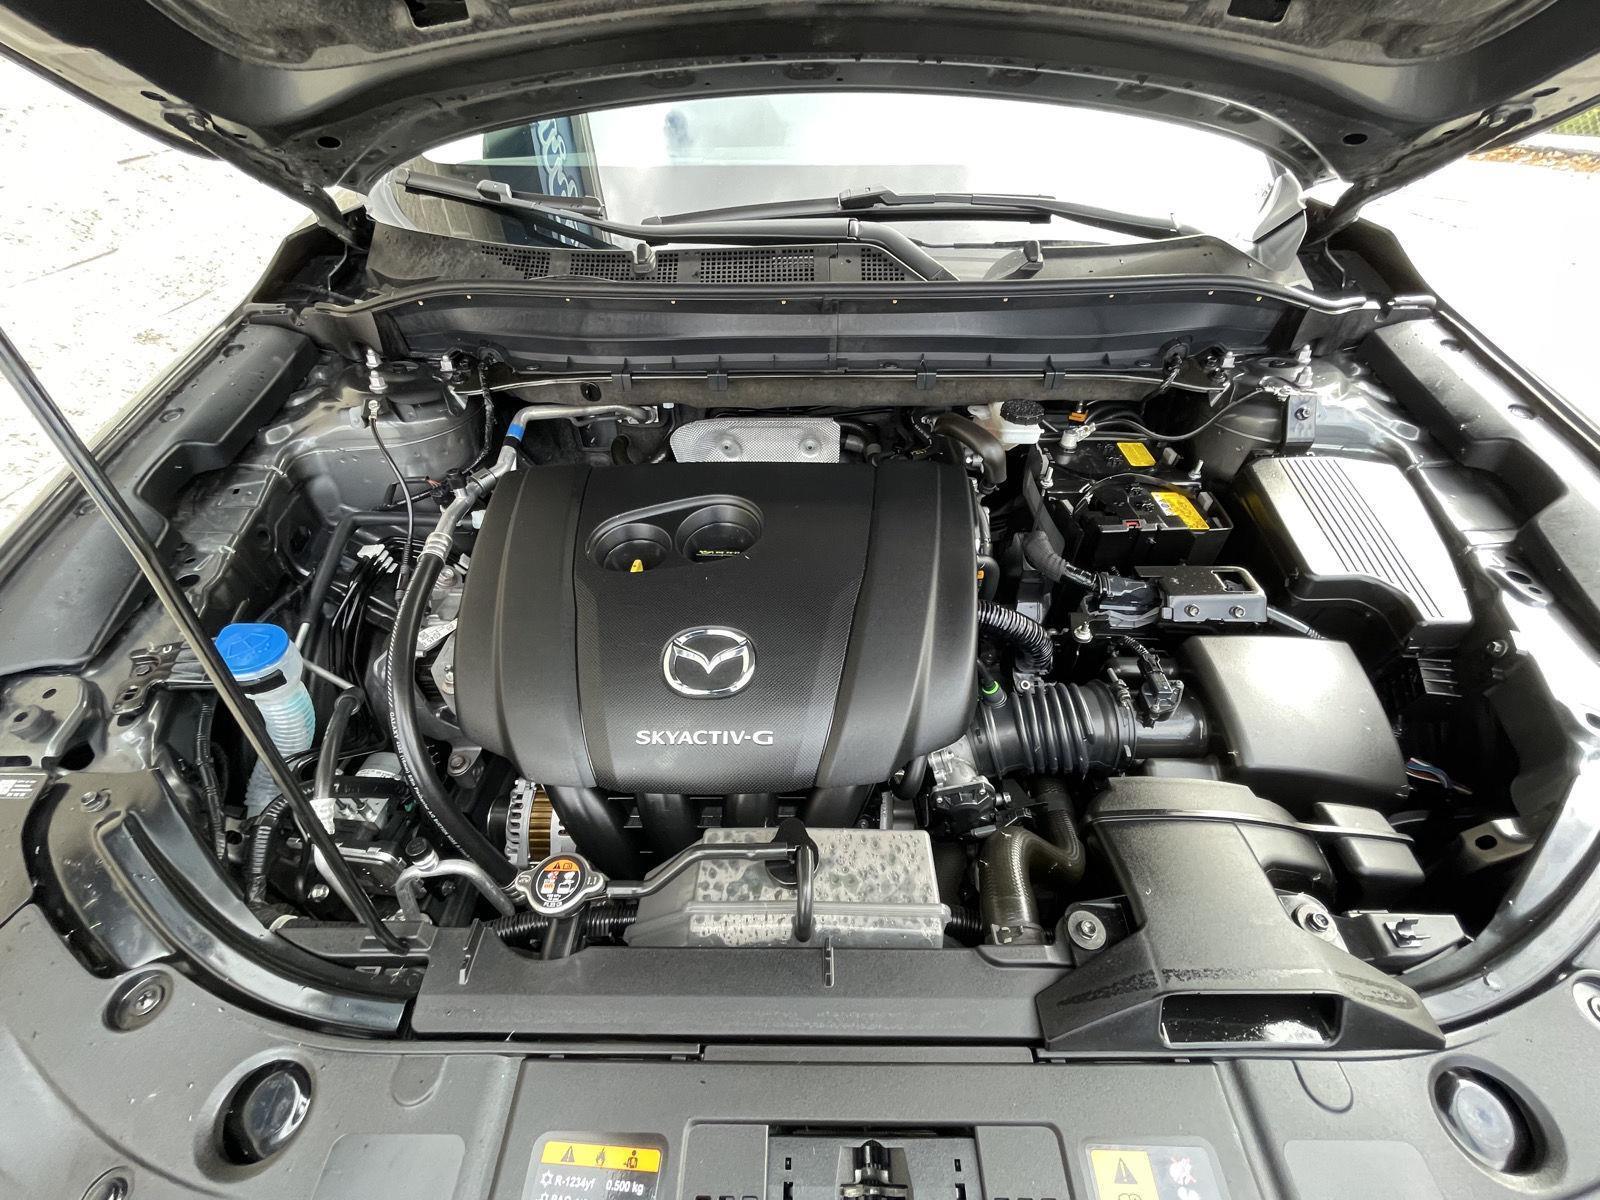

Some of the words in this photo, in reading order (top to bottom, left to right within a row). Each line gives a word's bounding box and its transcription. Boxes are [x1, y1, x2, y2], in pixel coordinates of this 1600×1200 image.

[390, 711, 399, 739] GALAXY
[635, 729, 774, 745] SKYACTIV-G
[554, 1174, 597, 1191] R-1234yf
[606, 1179, 631, 1193] 0.500
[631, 1181, 645, 1196] kg
